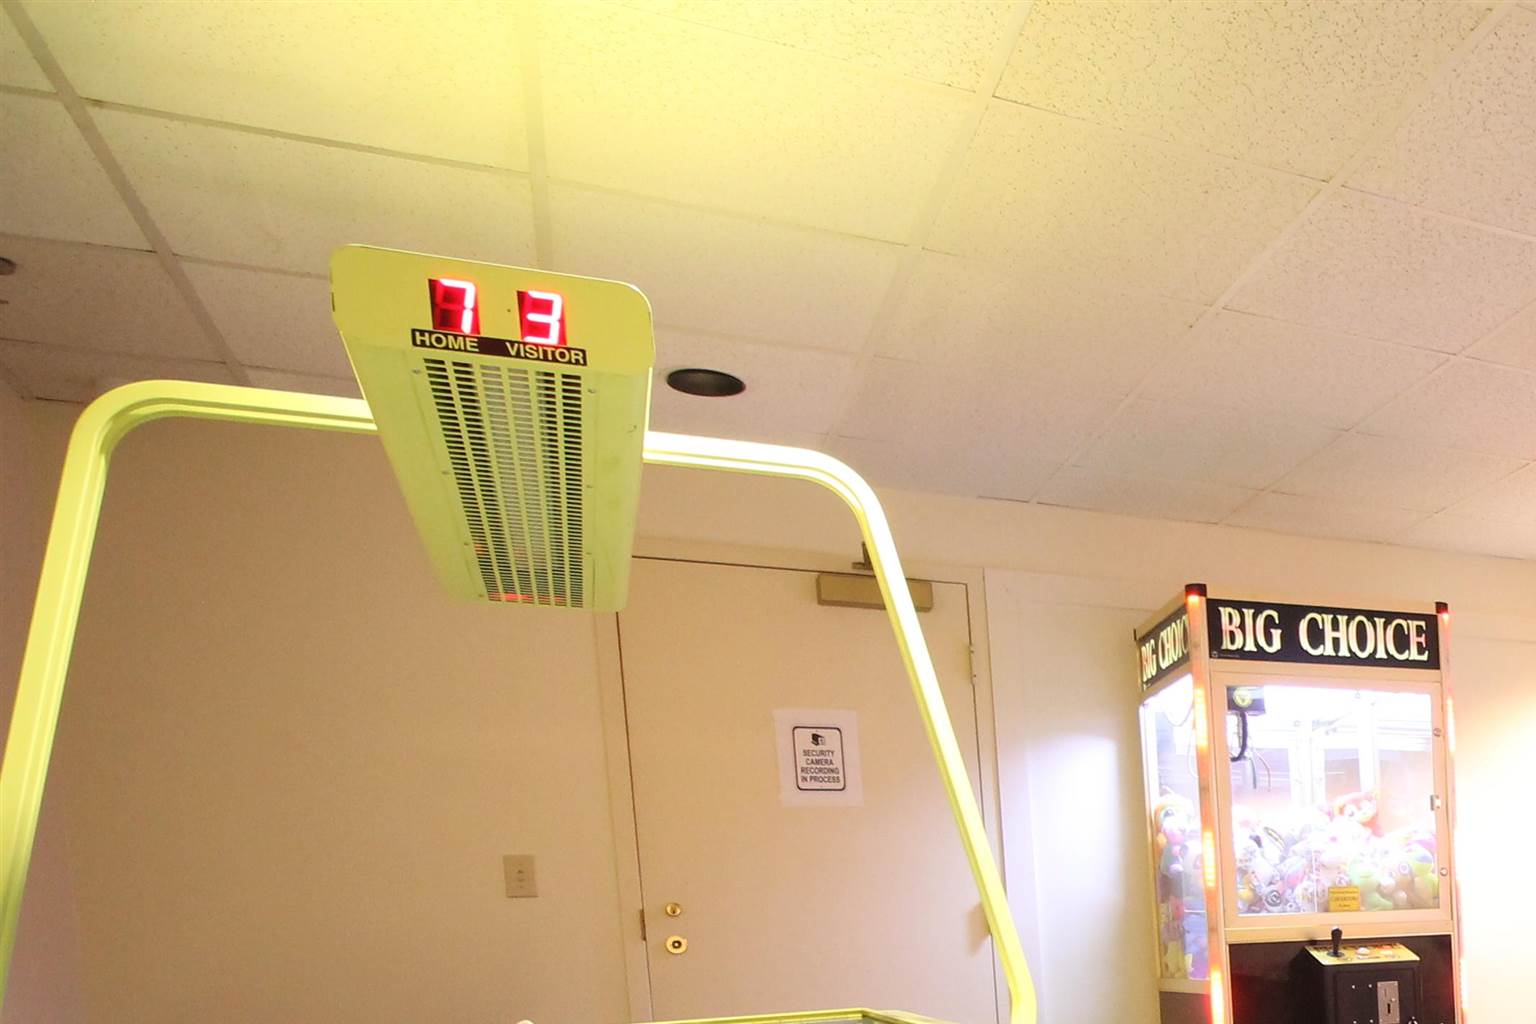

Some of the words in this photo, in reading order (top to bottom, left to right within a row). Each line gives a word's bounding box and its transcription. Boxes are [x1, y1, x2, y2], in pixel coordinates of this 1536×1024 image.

[438, 278, 476, 335] 7
[524, 291, 562, 345] 3
[414, 331, 480, 353] HOME
[505, 341, 586, 366] VISITOR
[1218, 606, 1283, 655] BIG
[1298, 611, 1430, 662] CHOICE
[1141, 638, 1158, 682] BIG
[1158, 613, 1189, 670] CHOIC
[803, 749, 835, 757] SECURITY
[805, 758, 834, 766] CAMERA
[800, 766, 839, 775] RECORDING
[800, 775, 808, 783] IN
[809, 776, 841, 784] PROCESS
